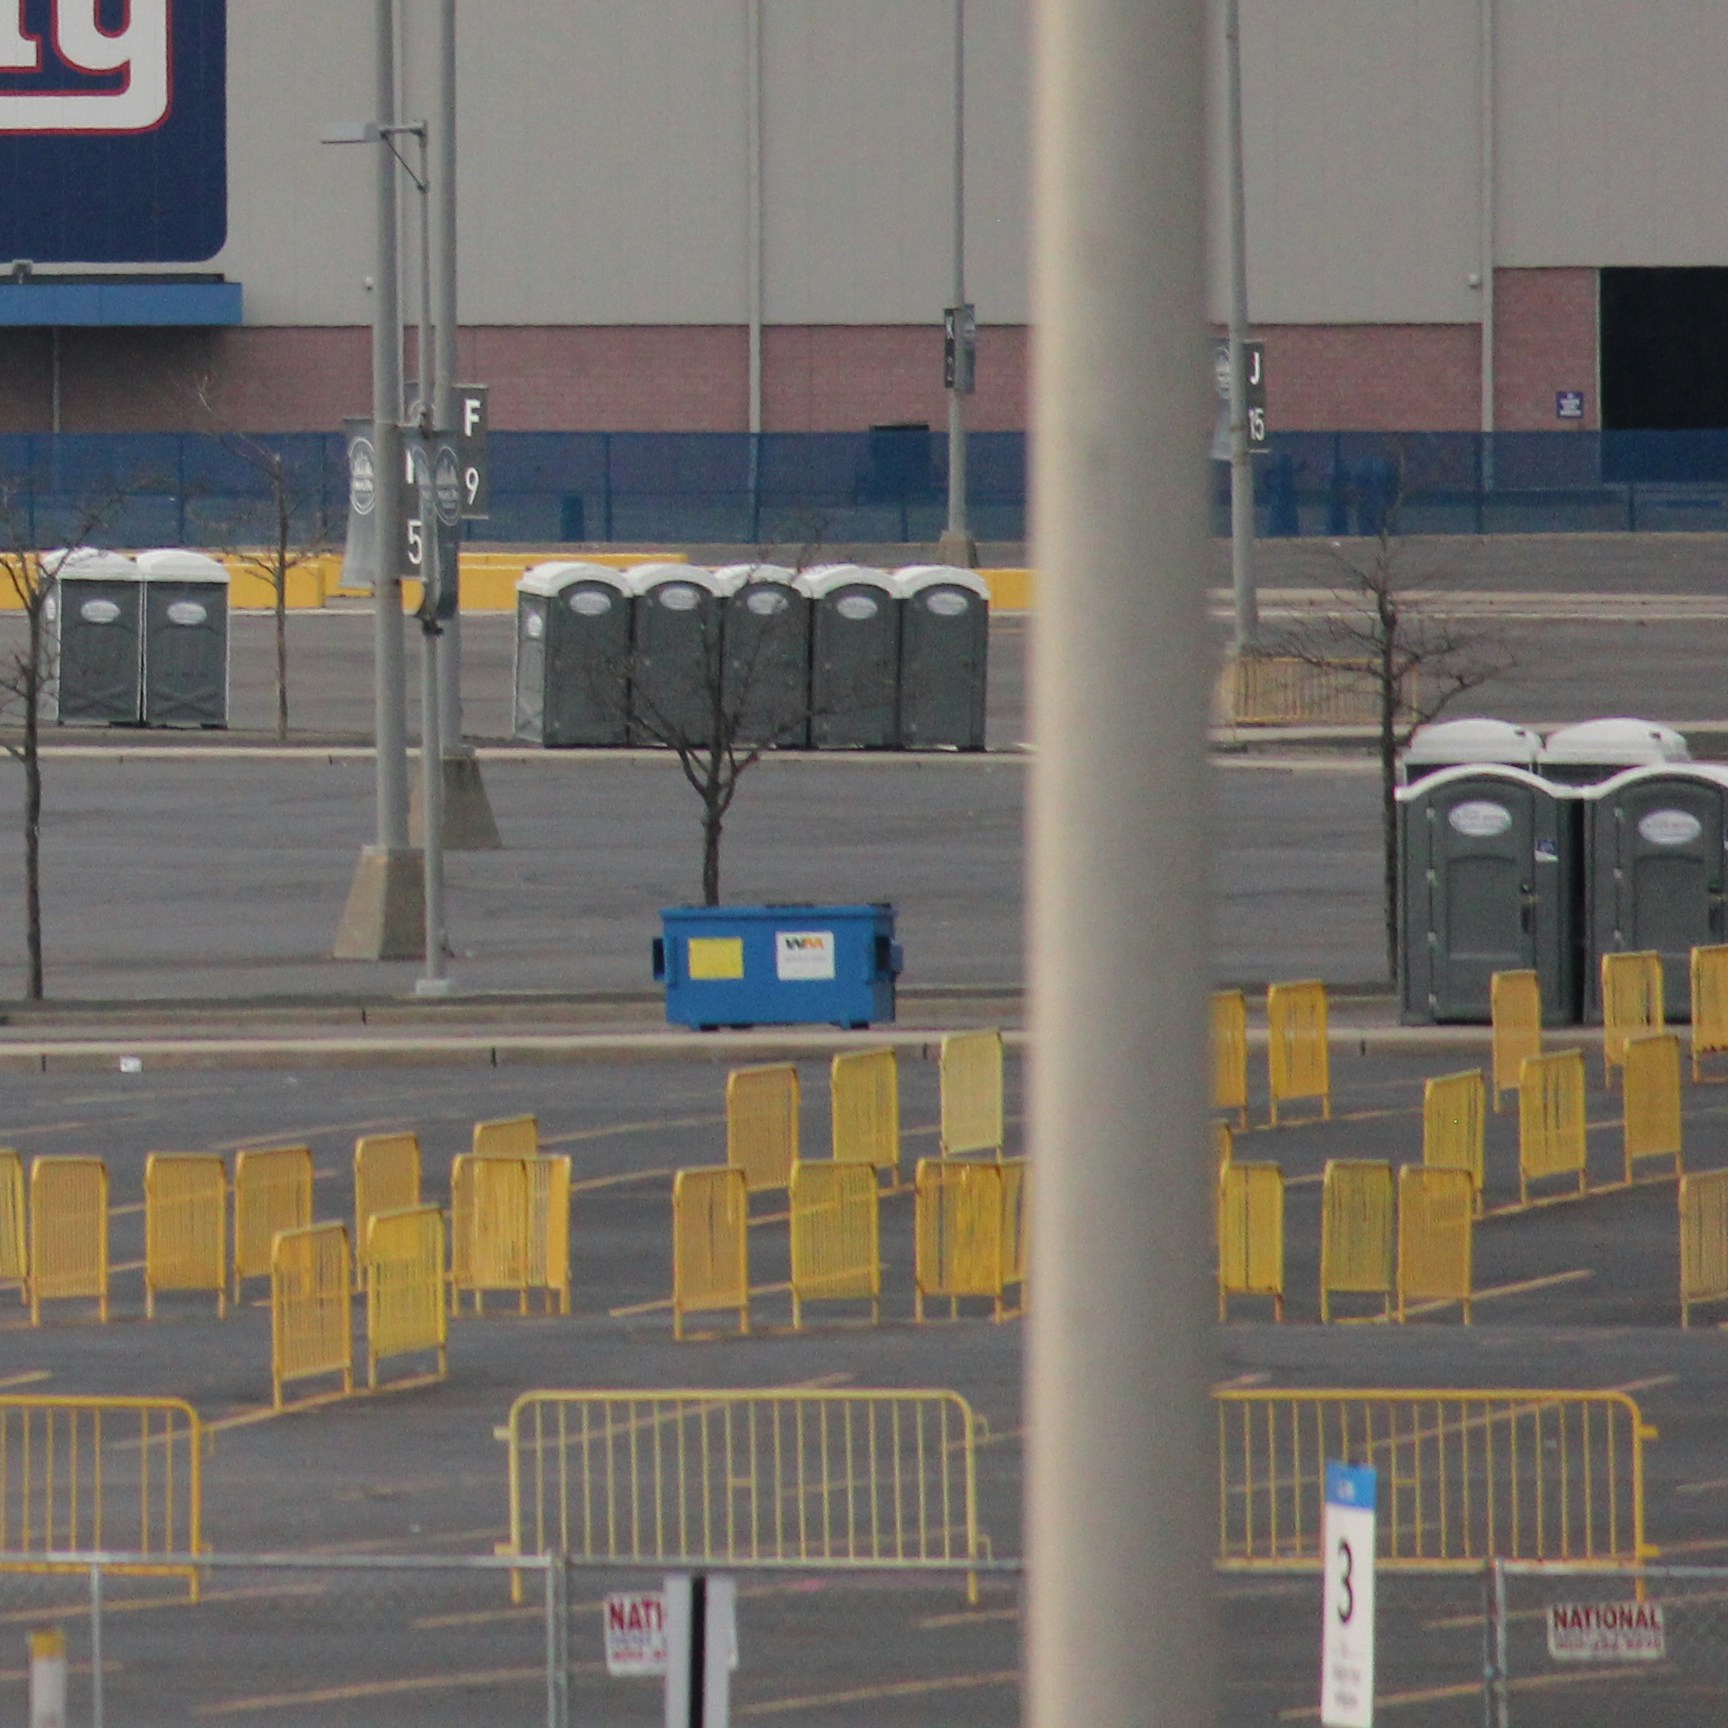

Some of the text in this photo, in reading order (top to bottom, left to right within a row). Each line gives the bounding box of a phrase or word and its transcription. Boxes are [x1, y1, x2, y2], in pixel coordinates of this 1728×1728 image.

[1250, 351, 1261, 385] J
[464, 398, 481, 437] F
[1248, 407, 1264, 441] 15
[464, 467, 479, 506] 9
[407, 519, 423, 565] 5
[785, 936, 825, 950] WM
[1337, 1537, 1353, 1623] 3
[609, 1600, 664, 1630] NATI
[1553, 1603, 1662, 1631] NATIONAL
